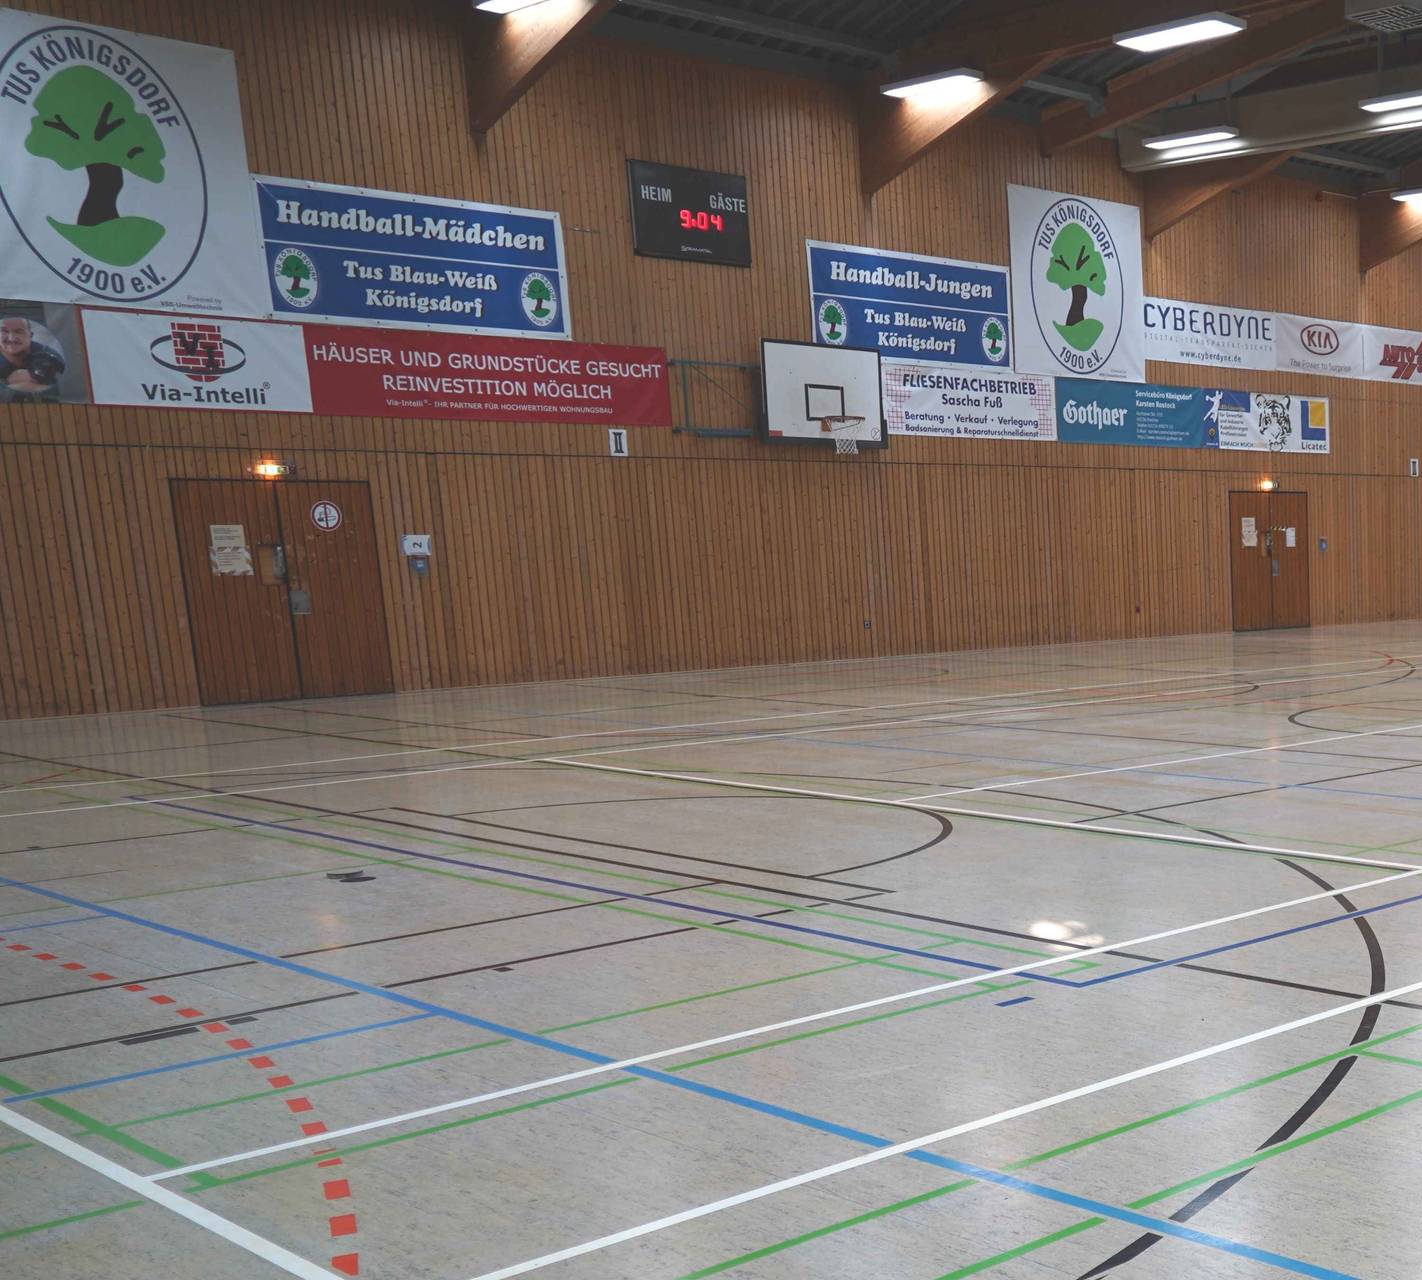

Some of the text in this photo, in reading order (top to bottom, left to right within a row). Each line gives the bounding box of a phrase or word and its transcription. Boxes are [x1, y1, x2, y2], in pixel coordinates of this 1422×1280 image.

[1, 33, 181, 130] TUS KÖNIGSDORF
[640, 184, 747, 214] HEIM GÄSTE
[276, 200, 546, 252] Handball-Mädchen
[679, 208, 724, 232] 9:04
[1038, 204, 1114, 262] TUS KÖNIGSDORF
[66, 256, 167, 295] 1900 e.V.
[343, 260, 498, 291] Tus Blau-Weiß
[830, 260, 993, 300] Handball-Jungen
[365, 288, 484, 318] Königsdorf
[864, 308, 890, 325] Tus
[894, 311, 967, 333] Blau-Weiß
[1143, 303, 1273, 341] CYBERDYNE
[877, 331, 957, 355] Königsdorf
[1306, 329, 1334, 350] KIA
[312, 342, 662, 379] HÄUSER UND GRUNDSTÜCKE GESUCHT
[1059, 346, 1084, 369] 1900
[1179, 350, 1242, 363] www.cyberdyne.de
[1290, 358, 1301, 367] The
[1382, 343, 1415, 364] AUTO
[382, 374, 612, 400] REINVESTITION MÖGLICH
[902, 373, 1037, 396] FLIESENFACHBETRIEB
[1135, 390, 1193, 401] Servicebüro Königsdorf
[450, 402, 482, 410] PARTNER
[484, 402, 500, 410] FÜR
[501, 403, 558, 413] HOCHWERTIGEN
[560, 405, 614, 415] WOHNUNGSBAU
[941, 393, 1003, 409] Sascha Fuß
[904, 411, 1039, 428] Beratung Verkauf Verlegung
[1062, 399, 1128, 431] Gothaer
[905, 423, 955, 436] Badsanierung
[963, 427, 1039, 438] Reparaturschnelldienst
[1301, 441, 1328, 451] Licatec
